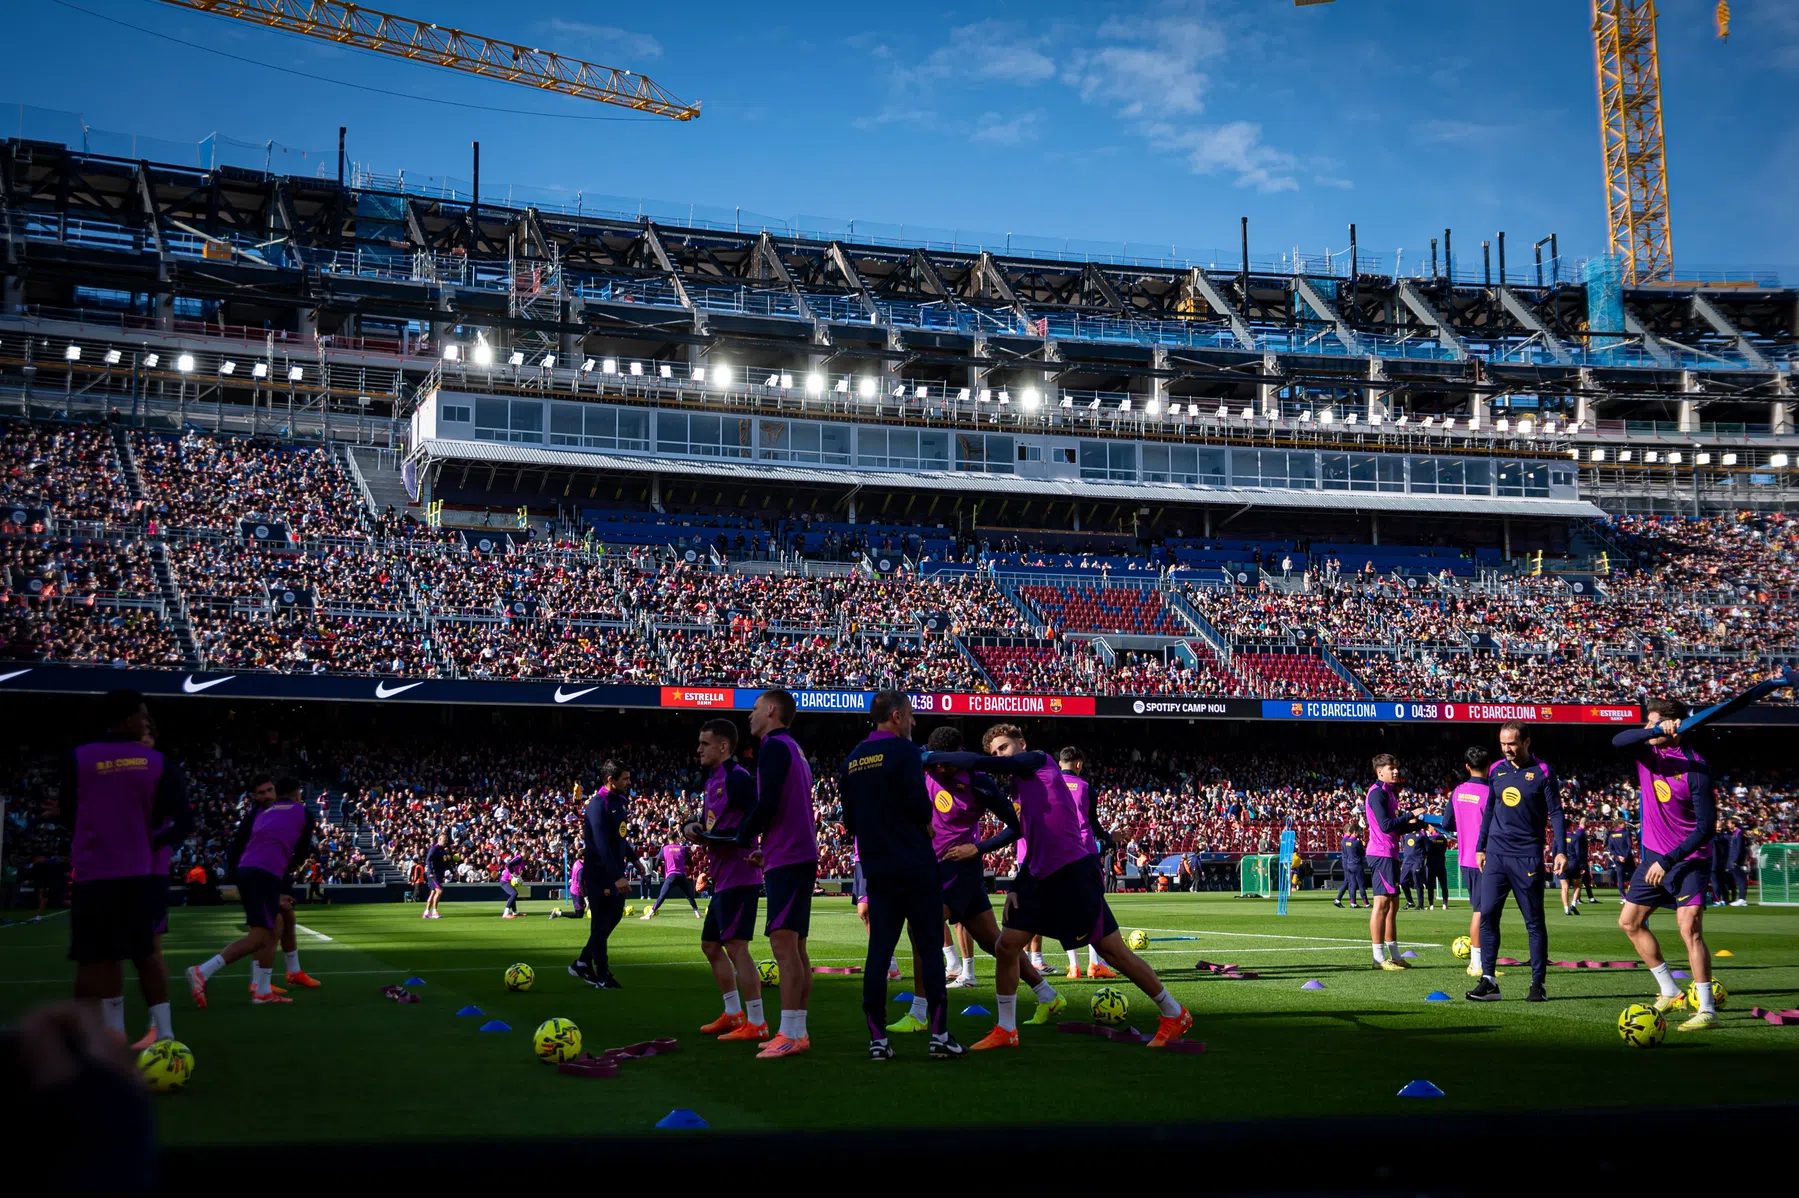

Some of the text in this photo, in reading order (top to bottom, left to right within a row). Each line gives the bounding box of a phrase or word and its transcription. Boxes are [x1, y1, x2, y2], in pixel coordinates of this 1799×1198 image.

[684, 692, 724, 701] ESTRELLA
[801, 693, 864, 709] BARCELONA
[908, 694, 952, 711] 4:38 0
[969, 696, 1044, 712] FC BARCELONA
[1146, 703, 1226, 713] SPOTIFY CAMP NOU
[1307, 703, 1377, 717] FC BARCELONA
[1395, 704, 1454, 719] 0 04:38 0
[1469, 705, 1537, 720] FC BARCELONA
[858, 754, 884, 766] CONGO
